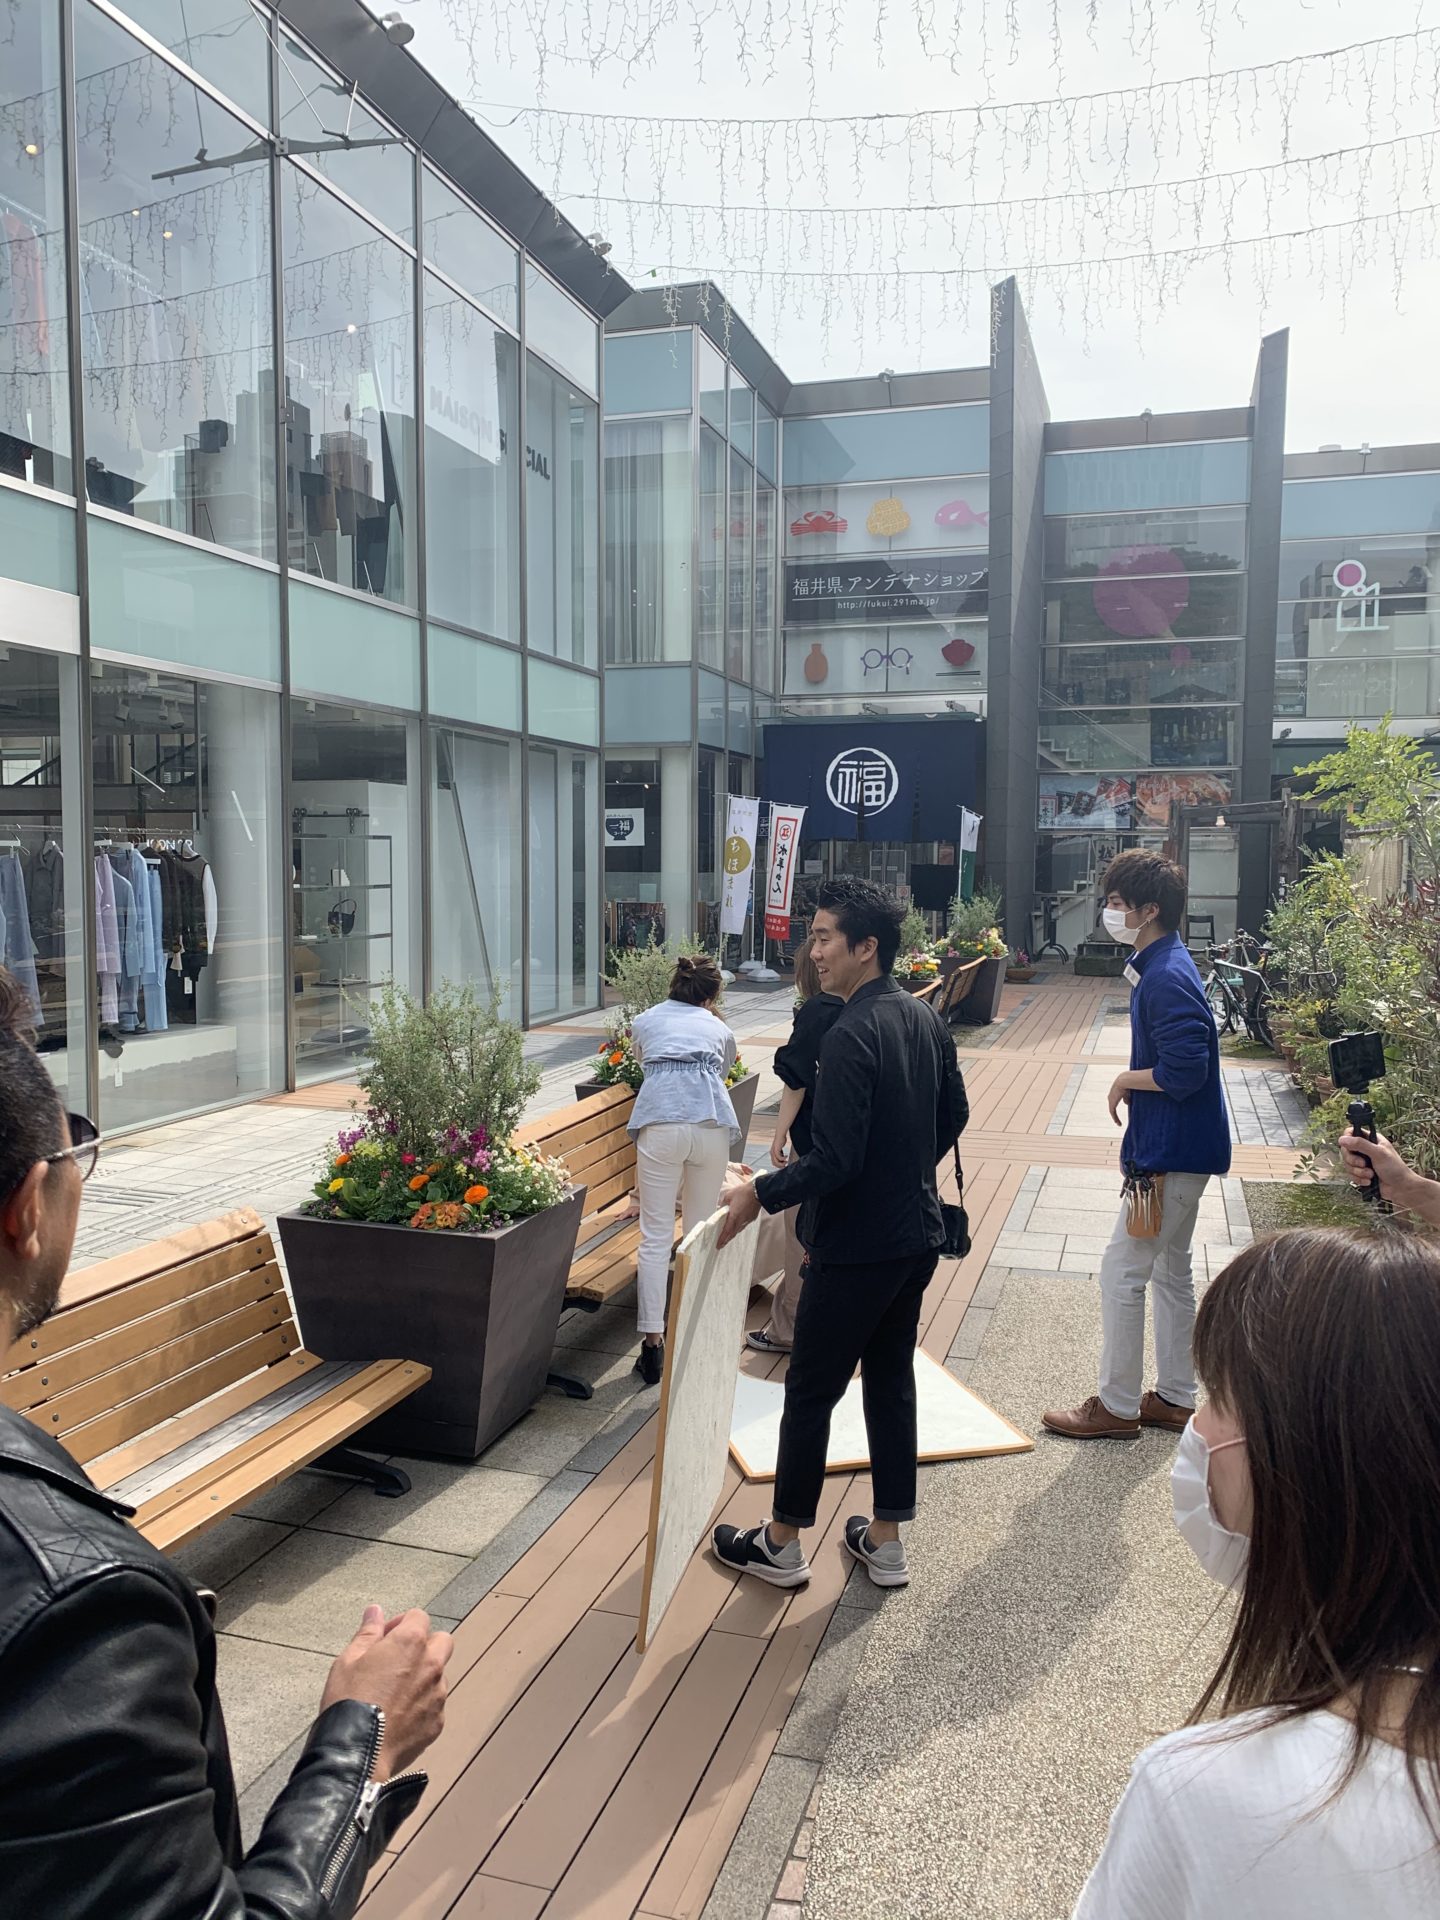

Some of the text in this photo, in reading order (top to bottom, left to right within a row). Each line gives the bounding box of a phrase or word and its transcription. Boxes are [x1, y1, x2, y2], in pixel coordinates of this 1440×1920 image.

[430, 385, 492, 443] MAISON
[837, 759, 887, 807] 福
[725, 825, 744, 908] いちほまれ
